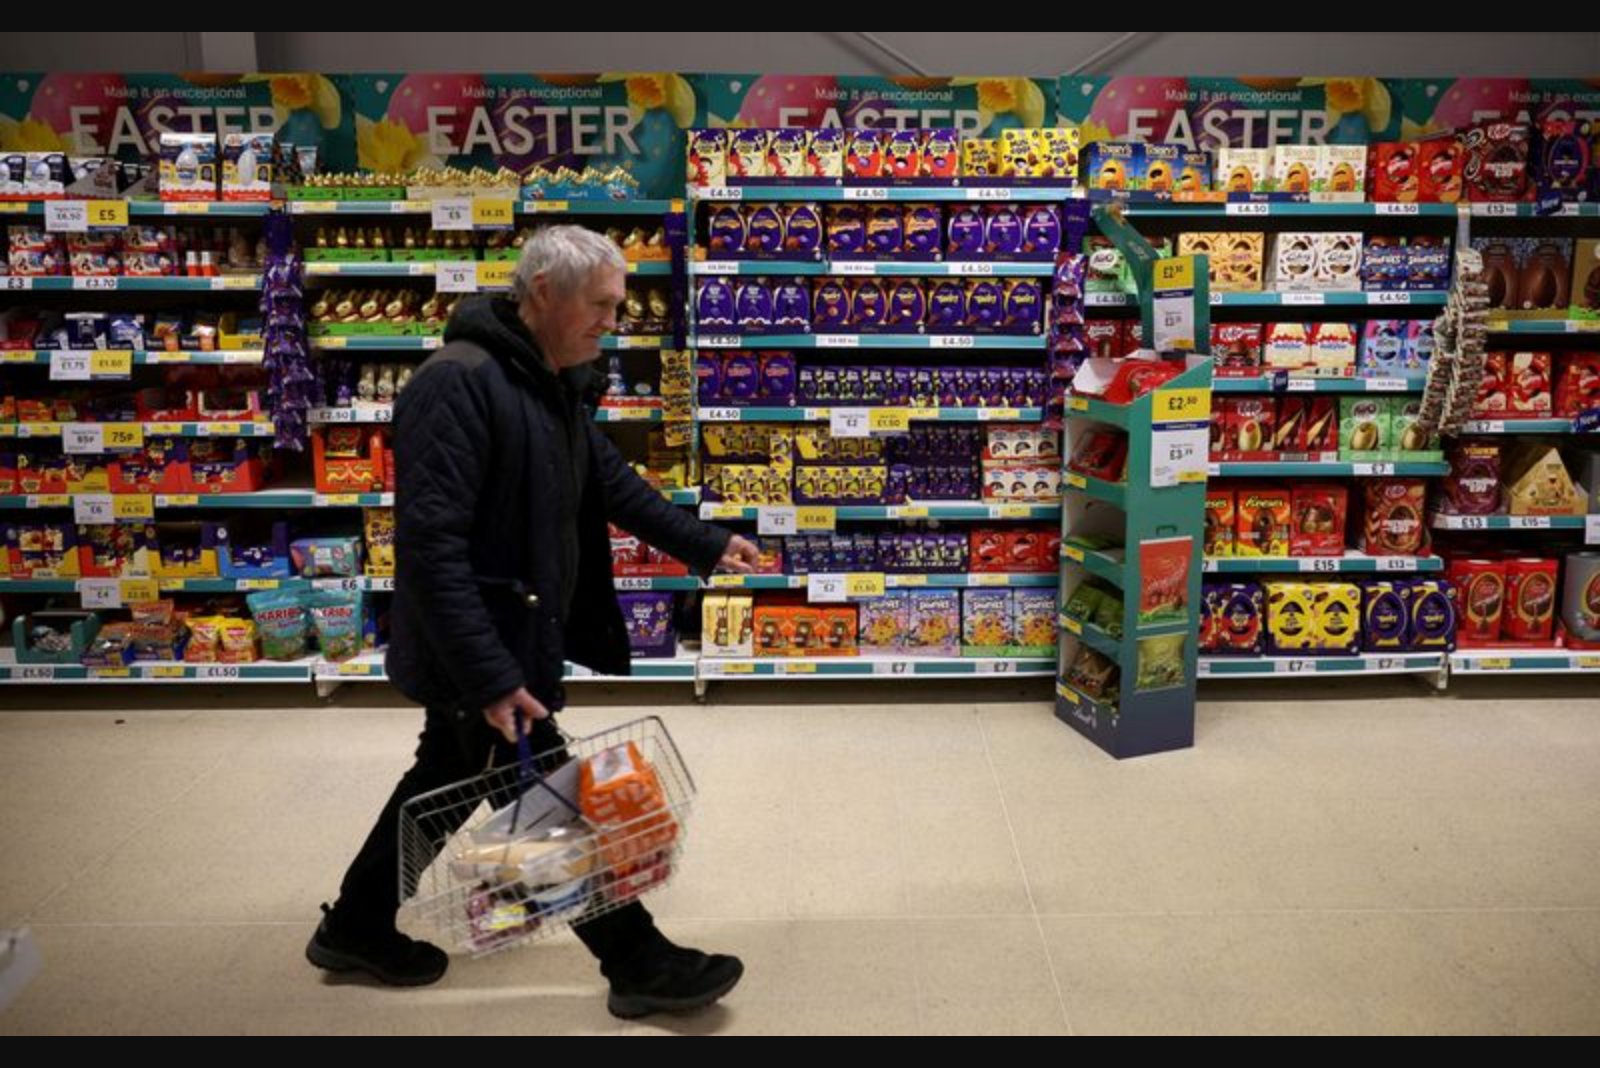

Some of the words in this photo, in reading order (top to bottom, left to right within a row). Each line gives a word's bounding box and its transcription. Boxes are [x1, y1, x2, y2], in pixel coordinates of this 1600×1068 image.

[104, 86, 137, 98] Make
[142, 86, 151, 98] it
[173, 86, 246, 101] exceptional
[462, 87, 495, 98] Make
[498, 87, 508, 98] it
[529, 87, 602, 101] exceptional
[816, 88, 847, 100] Make
[852, 88, 859, 100] it
[881, 88, 952, 103] exceptional
[1165, 90, 1197, 101] Make
[1201, 90, 1208, 101] it
[1230, 90, 1302, 104] exceptional
[427, 106, 640, 155] EASTER
[1128, 109, 1329, 152] EASTER
[710, 189, 740, 198] £4.50
[856, 189, 886, 198] £4.50
[979, 189, 1009, 198] £4.50
[1238, 205, 1266, 213] £4.50
[99, 210, 116, 220] £5
[961, 265, 990, 273] £4.50
[8, 278, 24, 288] £3
[86, 279, 115, 288] £3.70
[1096, 296, 1125, 304] £4.50
[1380, 294, 1408, 302] £4.50
[942, 337, 971, 345] £4.50
[375, 410, 391, 421] £3
[709, 410, 738, 419] £4.50
[846, 418, 857, 427] £2
[1372, 465, 1385, 474] £7
[91, 506, 102, 515] £6
[1462, 517, 1483, 527] £13
[1313, 560, 1334, 570] £15
[341, 580, 358, 590] £6
[892, 663, 907, 673] £7
[994, 663, 1009, 672] £7
[1289, 661, 1303, 670] £7
[1378, 660, 1392, 669] £7
[208, 667, 236, 677] £1.50
